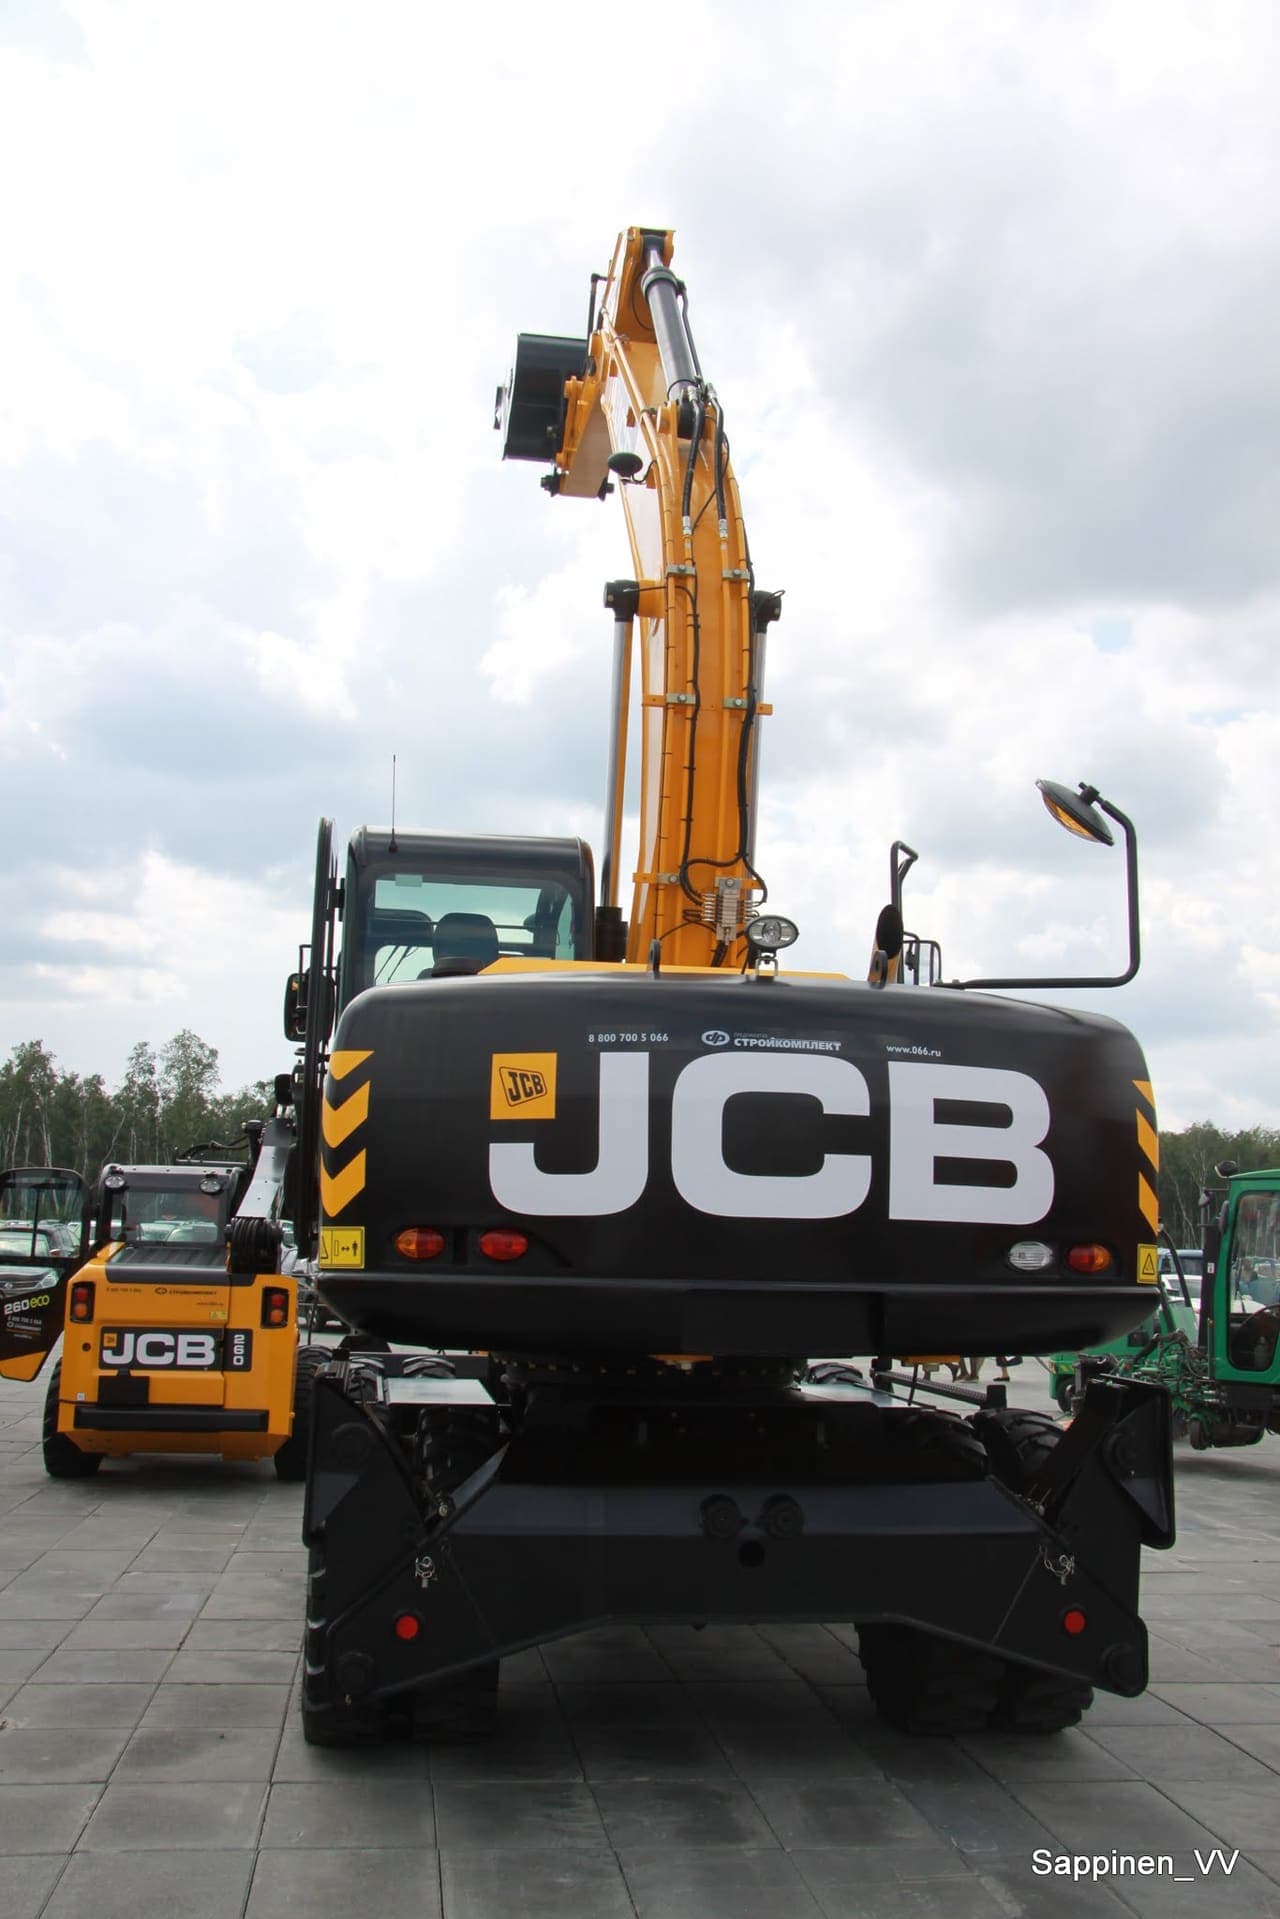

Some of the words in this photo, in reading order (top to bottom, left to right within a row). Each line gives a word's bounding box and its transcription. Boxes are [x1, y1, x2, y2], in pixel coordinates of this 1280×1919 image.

[588, 1033, 595, 1043] 8
[598, 1033, 616, 1042] 800
[619, 1033, 638, 1042] 700
[641, 1033, 647, 1042] 5
[650, 1033, 669, 1042] 066
[734, 1037, 841, 1051] СТРОЙКОМПЛЕКТ
[886, 1045, 942, 1057] www.066.ru
[508, 1071, 544, 1102] JCB
[489, 1052, 1055, 1225] JCB
[102, 1333, 215, 1365] JCB
[233, 1334, 245, 1366] 260
